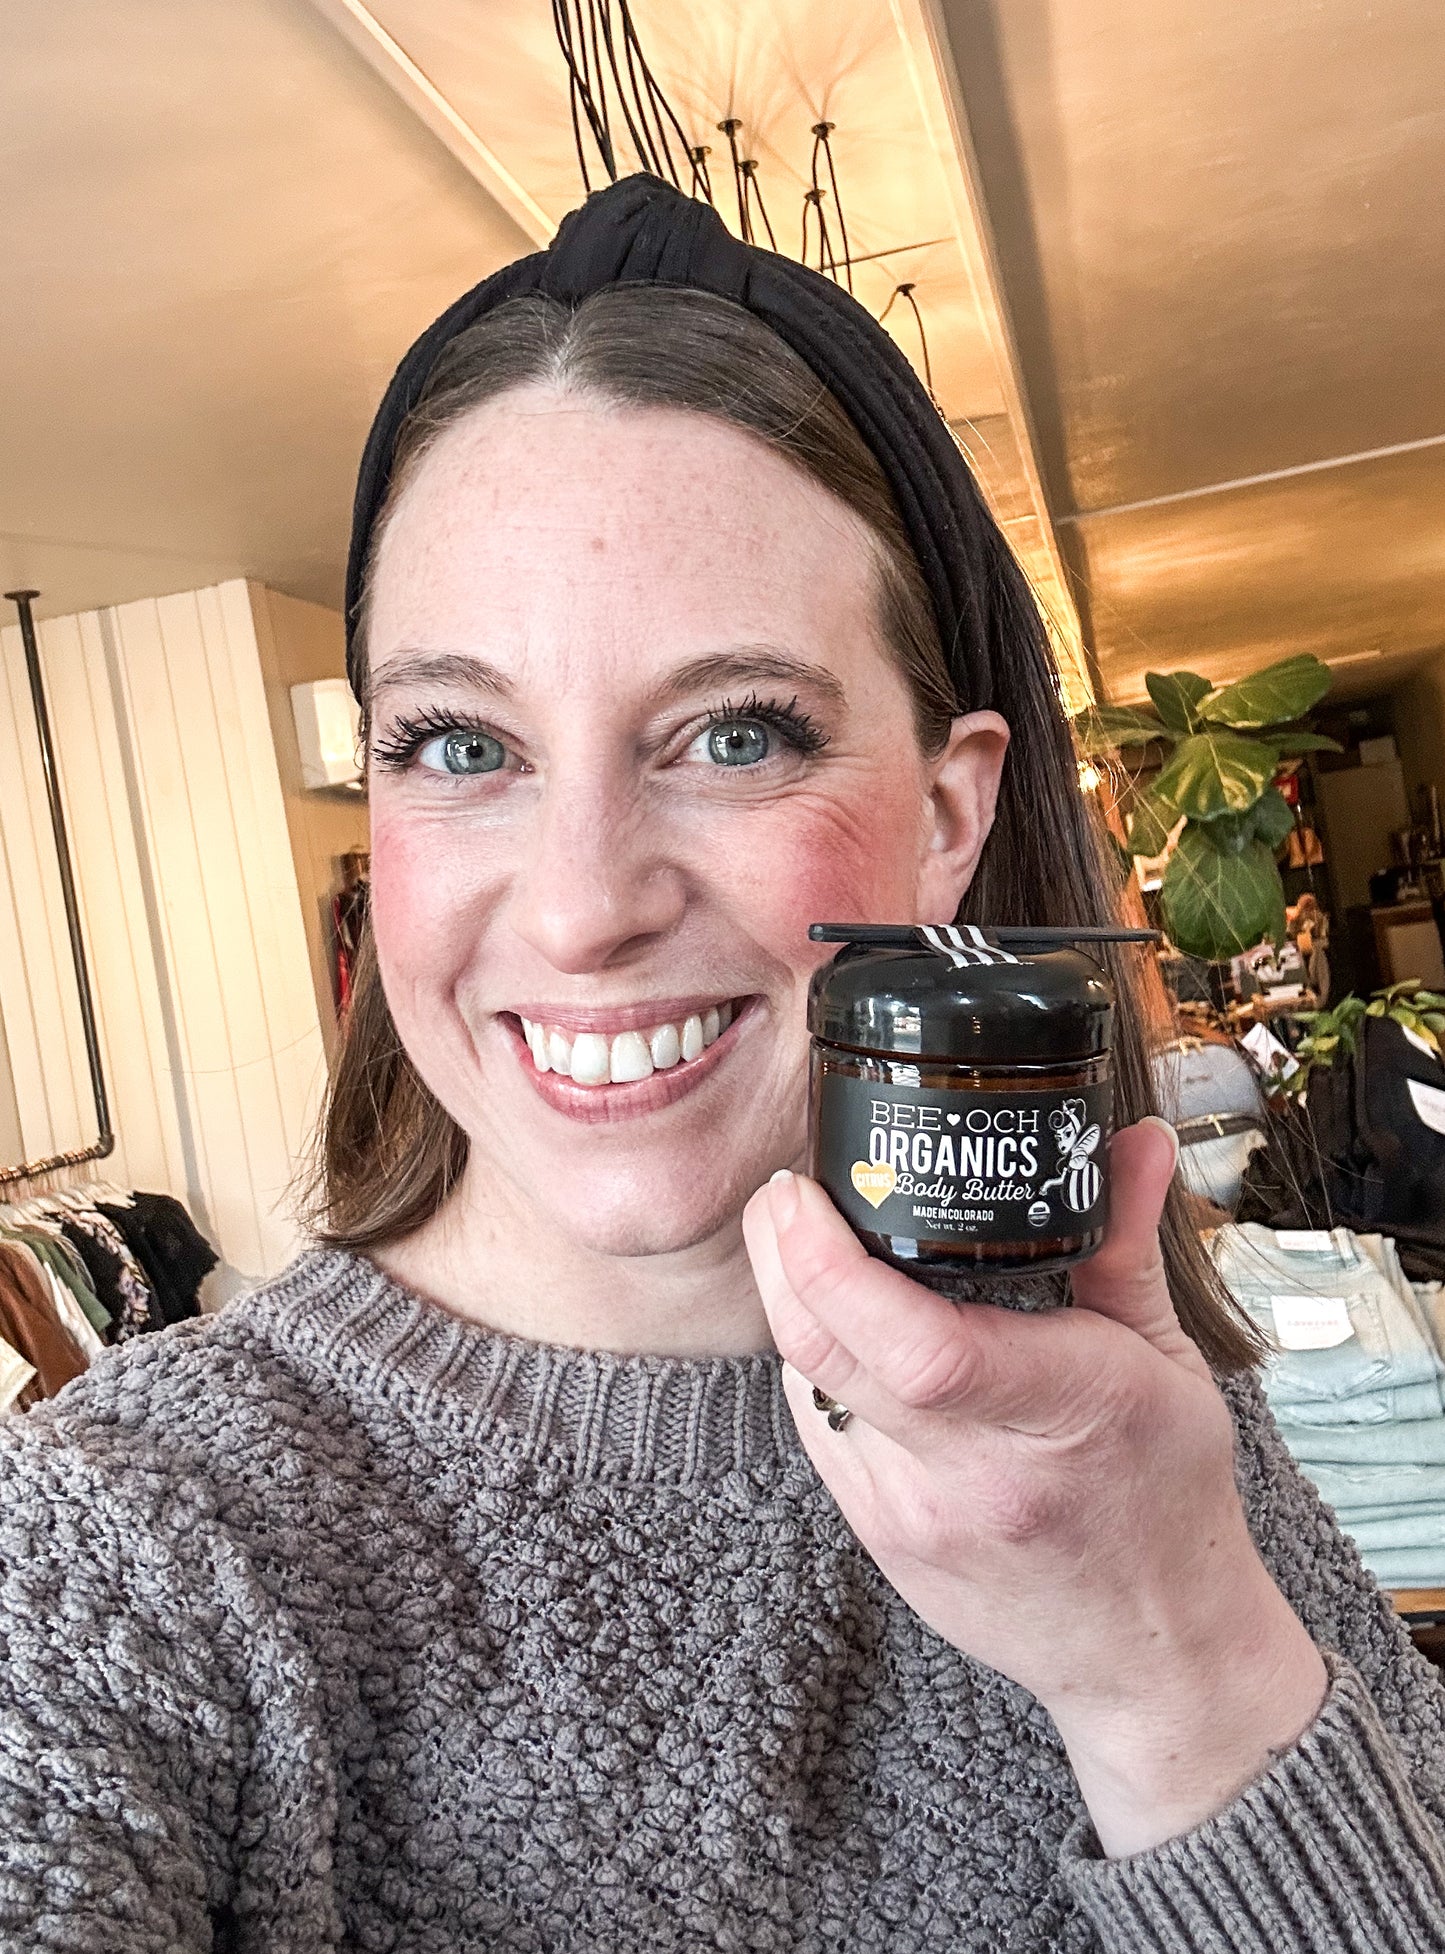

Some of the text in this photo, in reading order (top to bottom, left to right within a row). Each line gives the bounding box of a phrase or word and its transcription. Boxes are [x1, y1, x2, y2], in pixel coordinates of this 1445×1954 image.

[870, 1100, 1040, 1133] BEE OCH
[869, 1126, 1038, 1178] ORGANICS
[894, 1172, 1036, 1206] Body Butter
